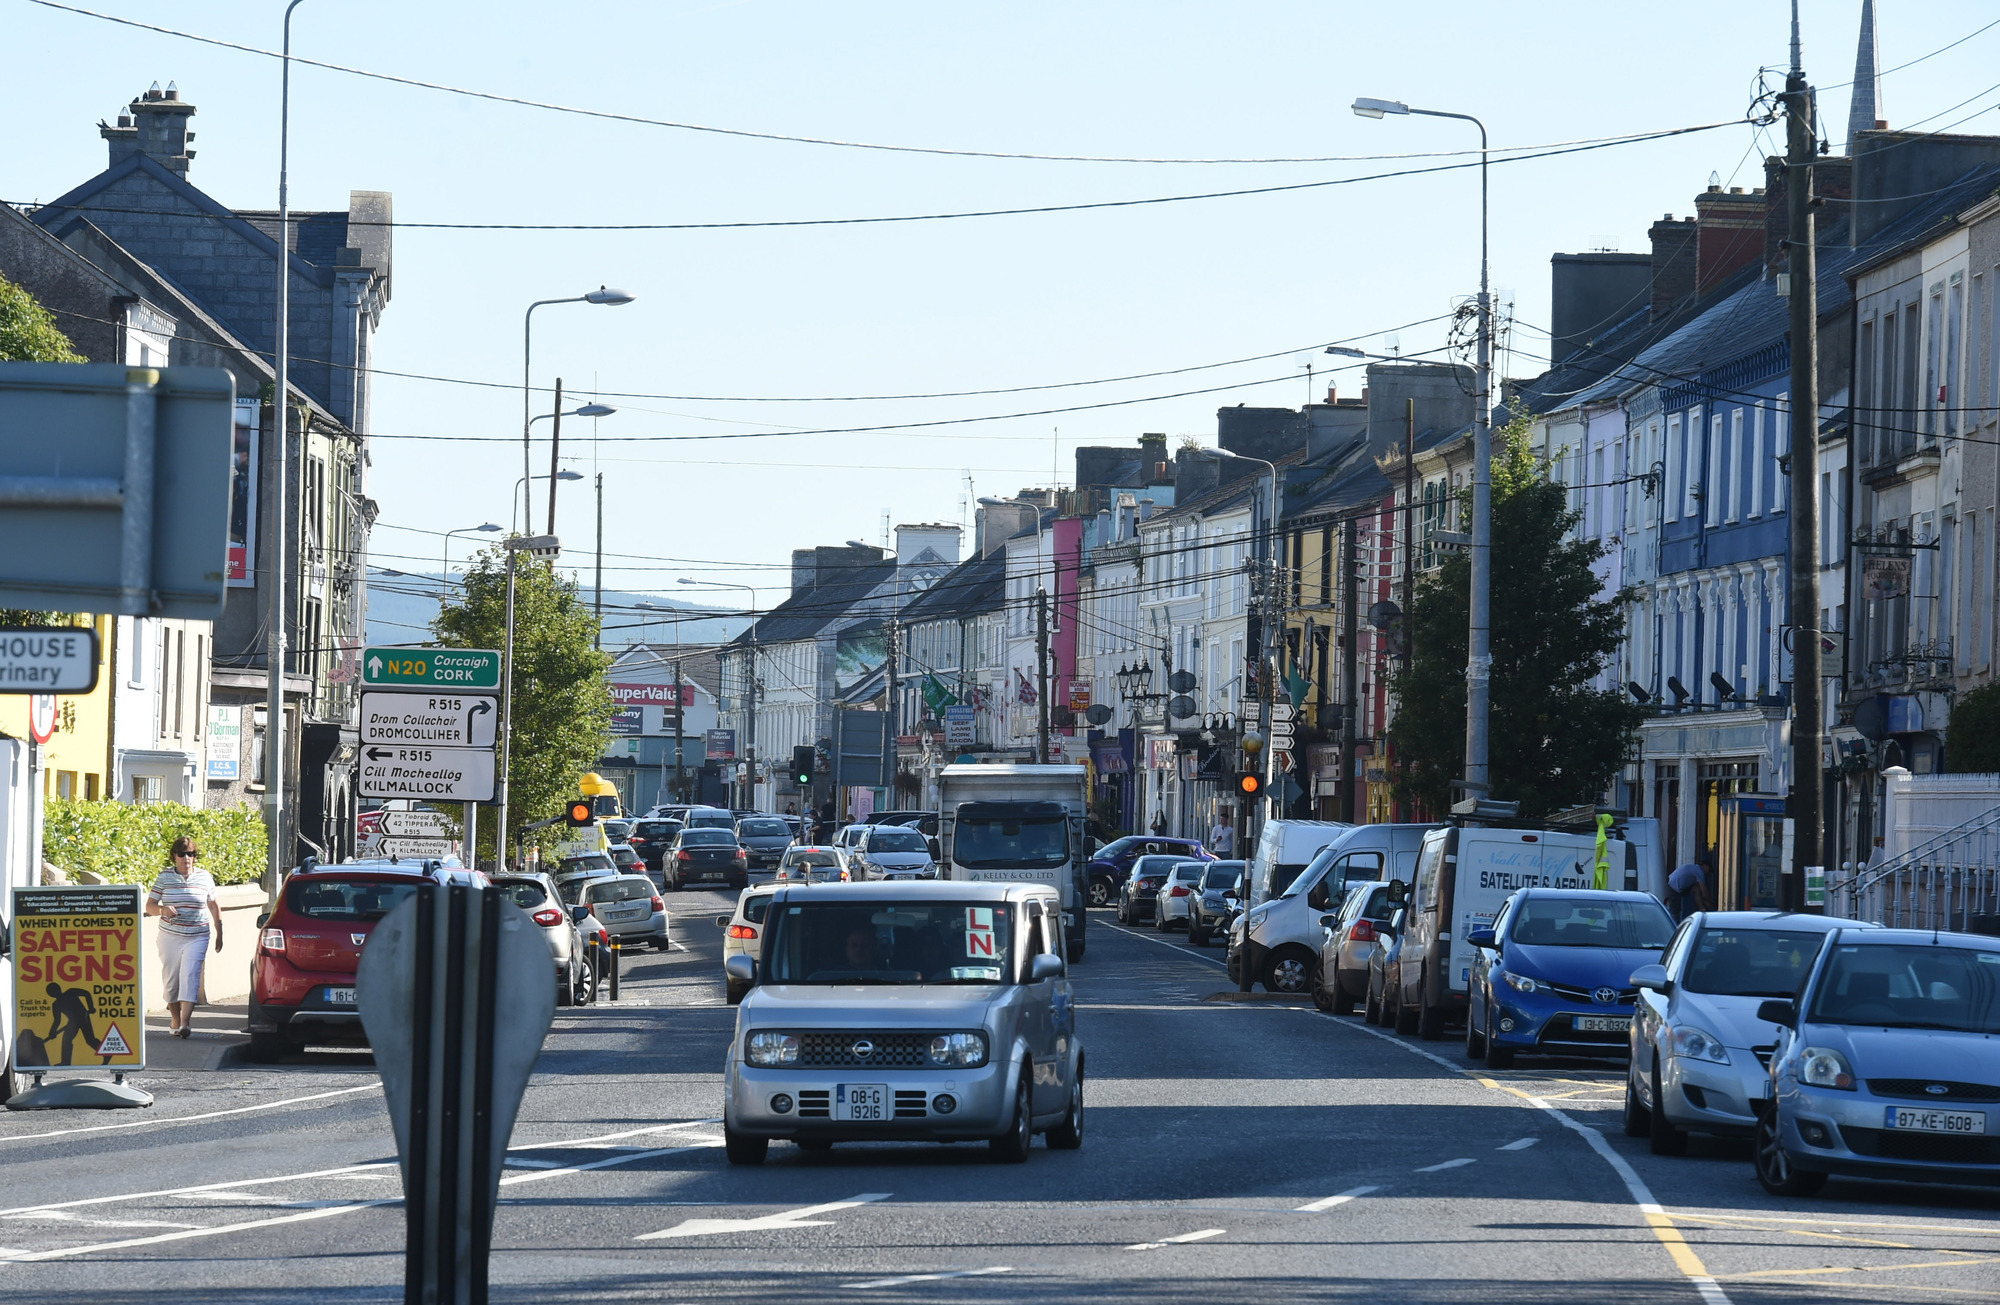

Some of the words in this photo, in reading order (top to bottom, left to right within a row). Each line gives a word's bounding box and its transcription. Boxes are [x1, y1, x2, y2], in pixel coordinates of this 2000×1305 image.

[388, 660, 427, 676] N20
[434, 654, 489, 669] Corcaigh
[434, 669, 474, 681] CORK
[1070, 700, 1089, 709] Toys
[370, 713, 398, 724] Drom
[403, 714, 458, 726] Collachair
[370, 727, 461, 741] DROMCOLLIHER
[364, 766, 386, 777] Cill
[364, 781, 454, 794] KILMALLOCK
[1480, 871, 1538, 890] SATELLITE
[20, 919, 56, 928] WHEN
[60, 919, 70, 927] IT
[73, 918, 114, 927] COMES
[117, 918, 134, 926] TO
[970, 908, 990, 930] L
[20, 929, 134, 952] SAFETY
[970, 933, 992, 956] N
[20, 954, 134, 982] SIGNS
[94, 984, 136, 994] DON'T
[98, 996, 122, 1006] DIG
[126, 996, 135, 1006] A
[99, 1008, 136, 1018] HOLE
[851, 1090, 880, 1104] 08-G
[850, 1105, 880, 1118] 19216
